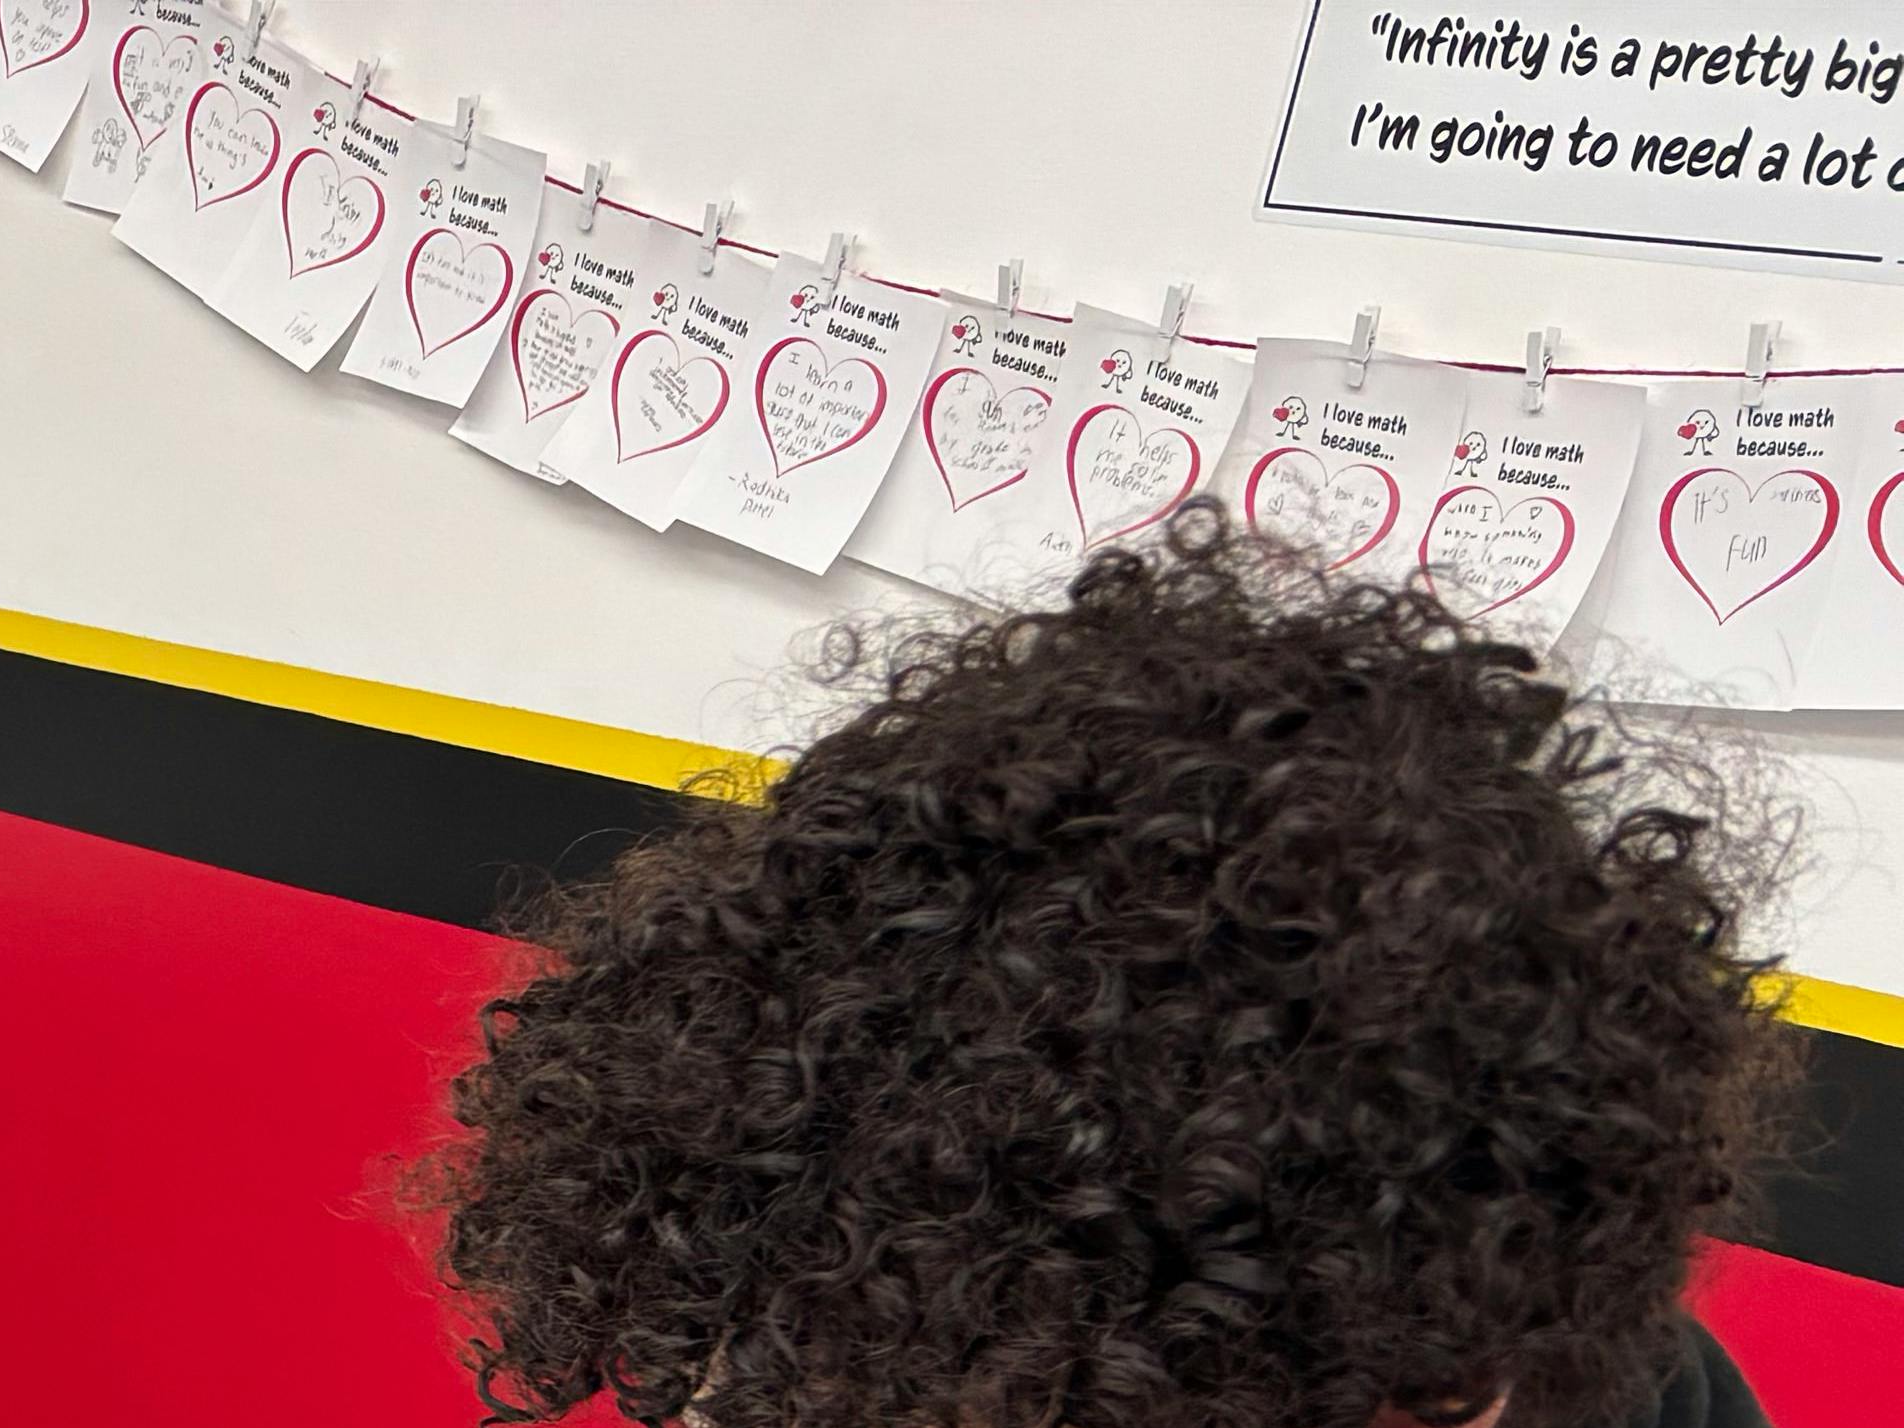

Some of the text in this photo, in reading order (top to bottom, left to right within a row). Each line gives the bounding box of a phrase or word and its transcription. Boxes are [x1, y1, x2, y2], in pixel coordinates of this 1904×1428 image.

[1372, 12, 1904, 104] "Infinity is a pretty big
[267, 67, 290, 90] math
[351, 118, 399, 157] love math
[1351, 102, 1878, 189] I'm going to need a lot
[458, 186, 507, 214] love math
[581, 253, 634, 288] love math
[695, 298, 748, 338] love math
[839, 296, 900, 331] love math
[1033, 339, 1066, 358] math
[1155, 362, 1219, 400] love math
[1333, 403, 1407, 436] love math
[1747, 407, 1834, 428] love math
[1511, 436, 1584, 464] love math
